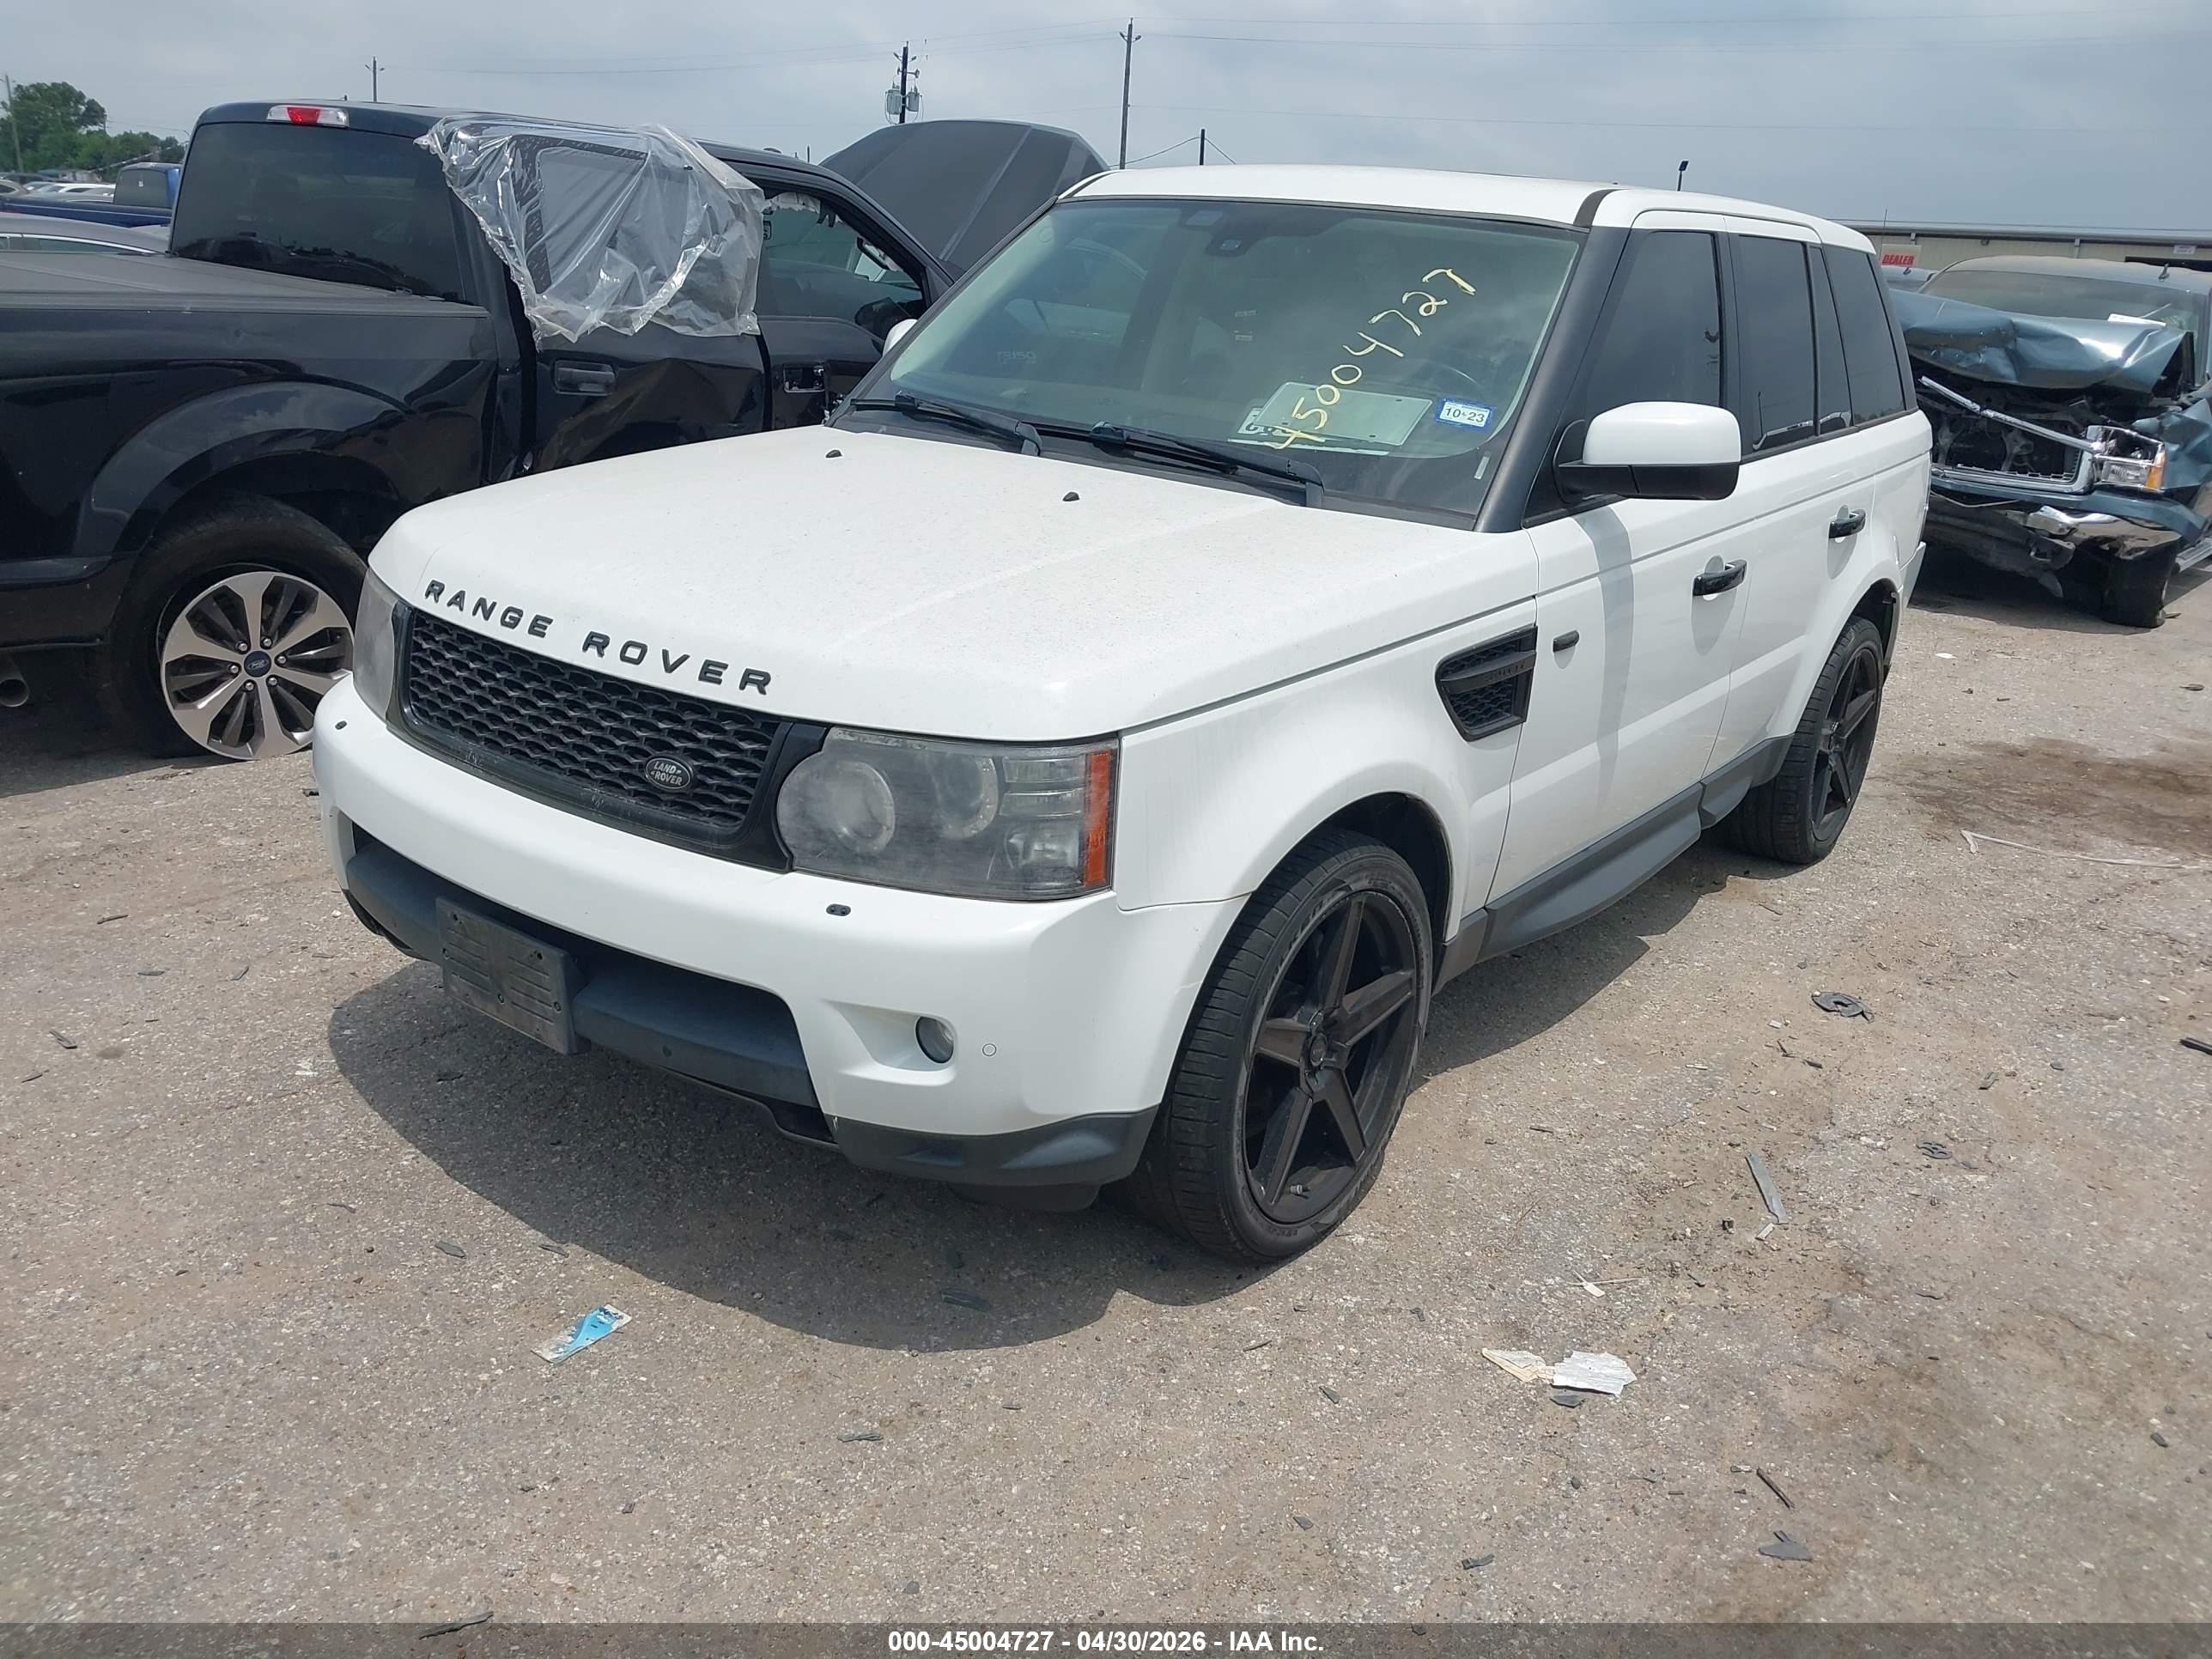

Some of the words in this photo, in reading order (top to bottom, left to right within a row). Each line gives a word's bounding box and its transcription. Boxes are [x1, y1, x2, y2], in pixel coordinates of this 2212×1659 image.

[1882, 254, 1915, 266] DEALER
[1263, 268, 1477, 450] 45004727
[424, 579, 554, 639] RANGE
[581, 630, 772, 696] ROVER
[653, 761, 677, 774] LAND
[654, 770, 683, 786] ROVER
